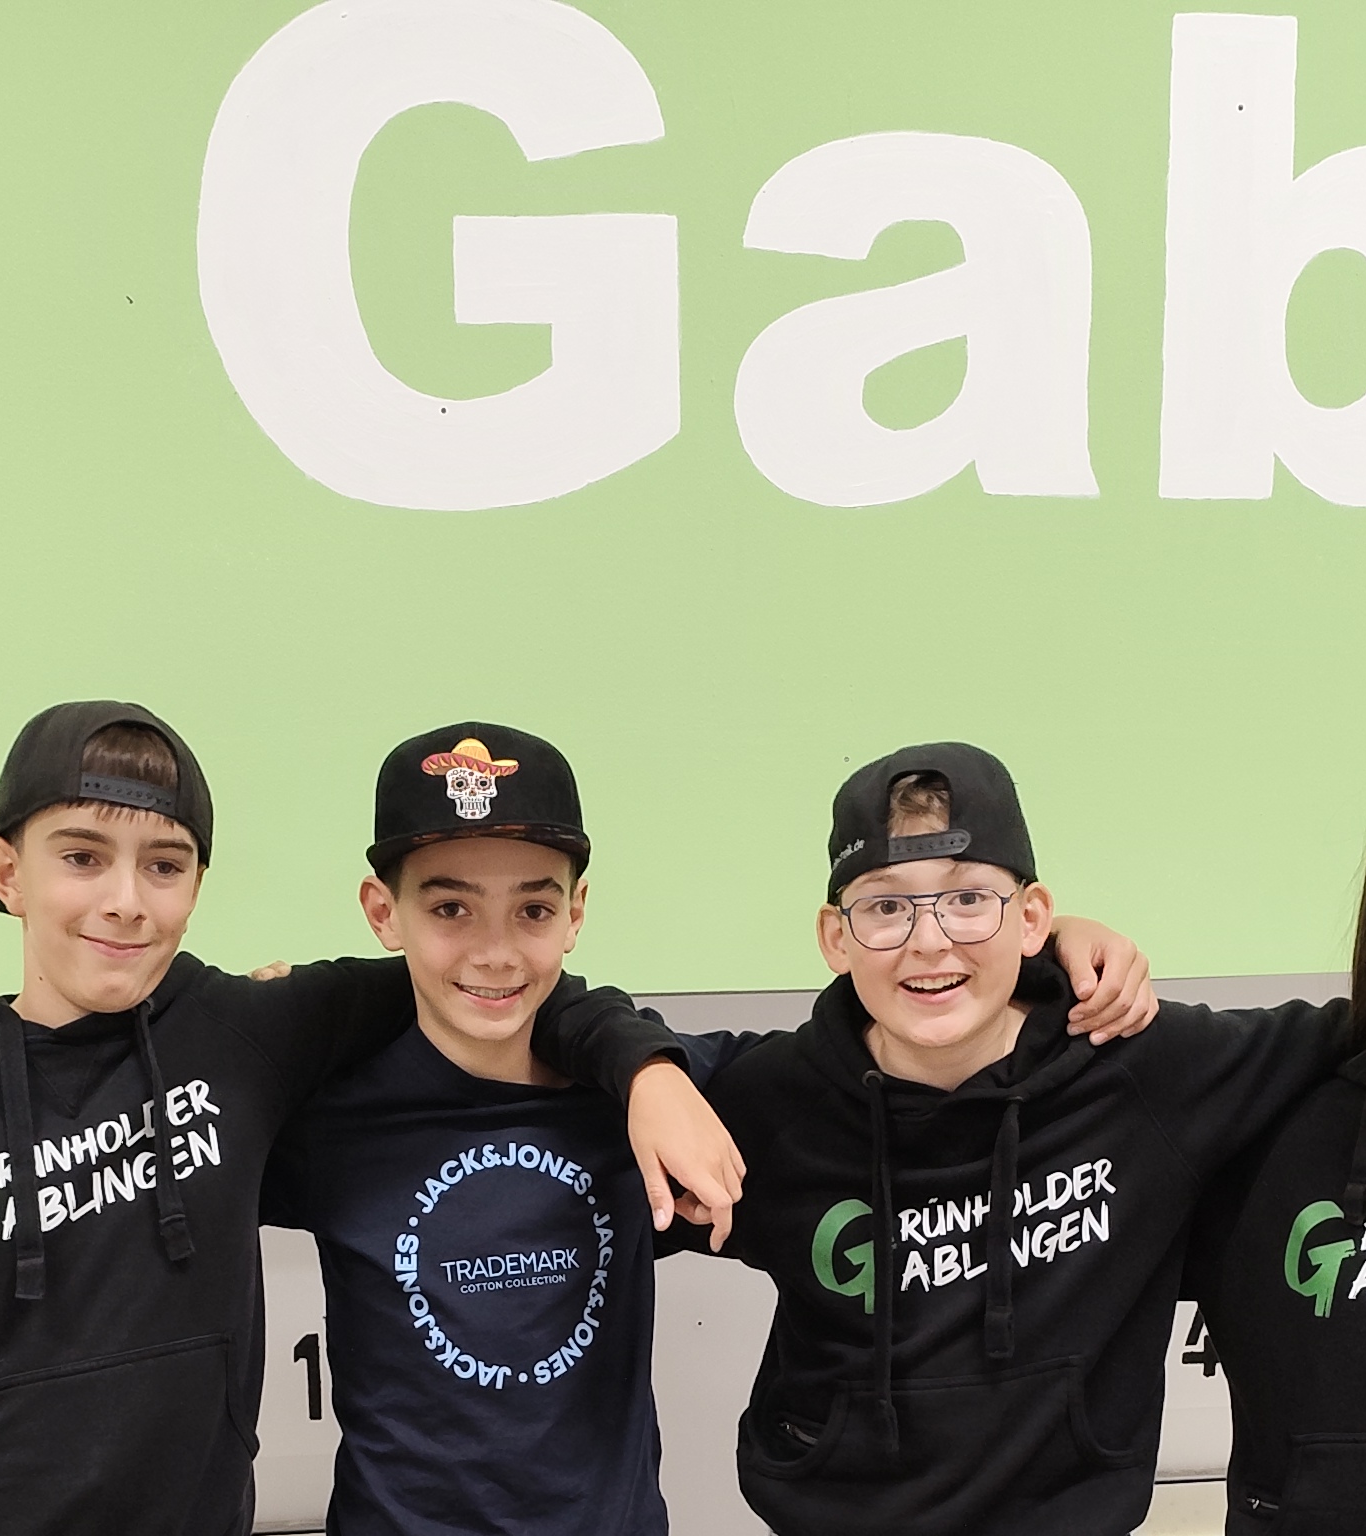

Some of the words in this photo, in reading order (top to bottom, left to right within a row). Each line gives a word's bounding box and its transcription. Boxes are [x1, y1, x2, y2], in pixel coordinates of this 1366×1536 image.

[414, 1142, 592, 1213] JACK&JONES
[440, 1248, 580, 1283] TRADEMARK
[460, 1280, 503, 1294] COTTON
[505, 1274, 567, 1289] COLLECTION
[900, 1200, 1110, 1292] ABLNGEN
[395, 1232, 512, 1389] JACK&JONES
[535, 1212, 614, 1385] JACK&JONES
